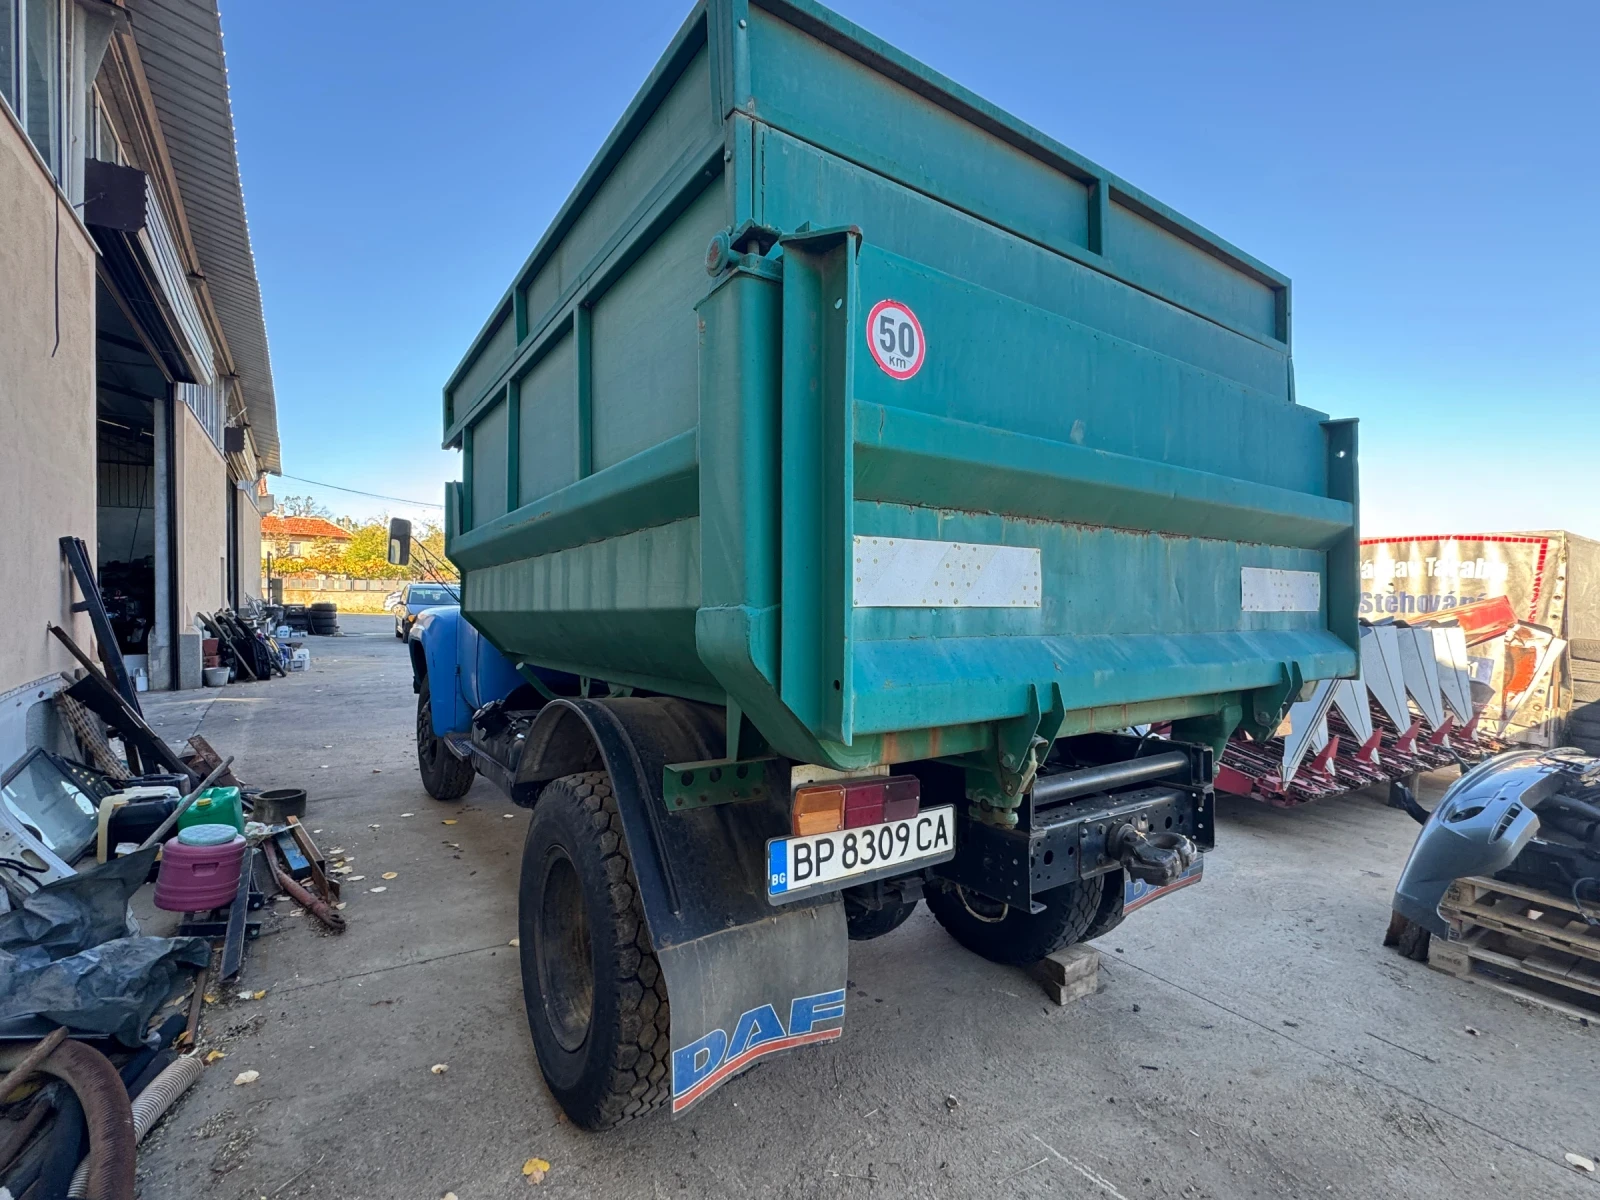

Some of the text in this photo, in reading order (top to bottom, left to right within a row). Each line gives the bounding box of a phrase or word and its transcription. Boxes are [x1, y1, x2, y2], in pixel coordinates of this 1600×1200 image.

[880, 315, 915, 358] 50
[794, 814, 948, 882] BP 8309 CA
[771, 873, 786, 886] BG
[673, 988, 846, 1098] DAF
